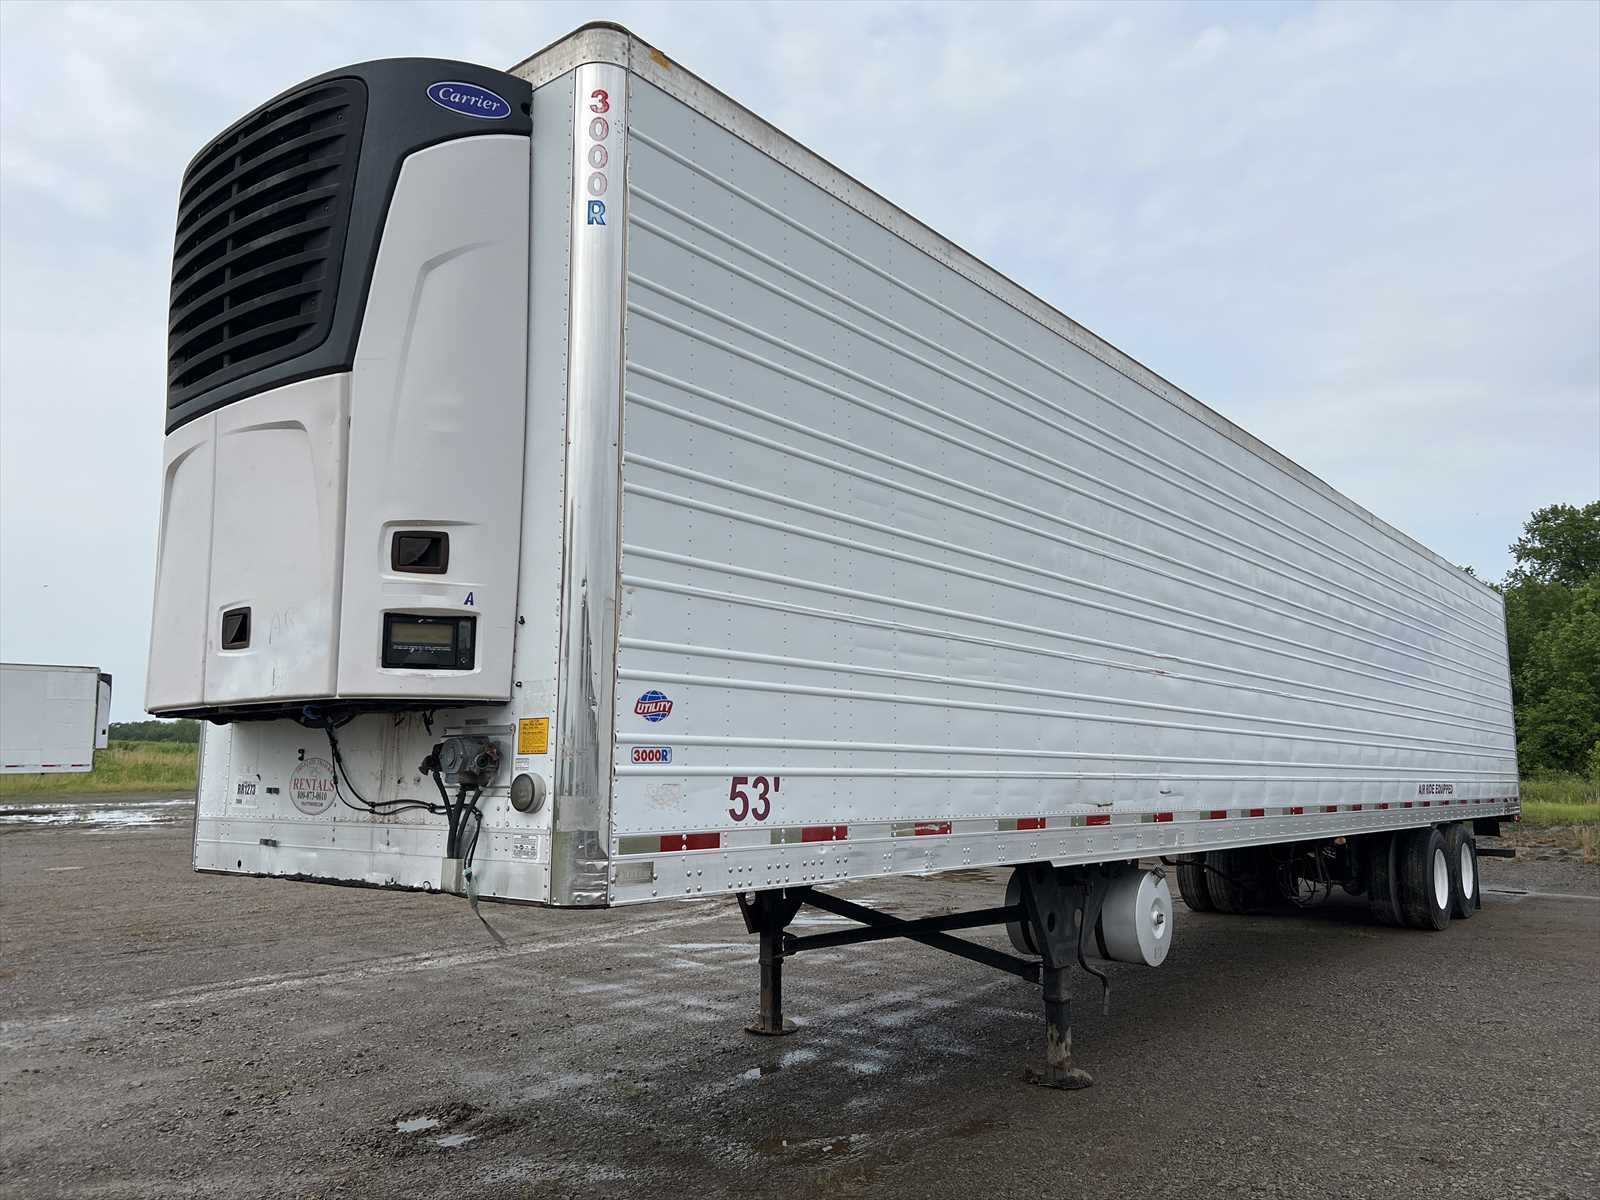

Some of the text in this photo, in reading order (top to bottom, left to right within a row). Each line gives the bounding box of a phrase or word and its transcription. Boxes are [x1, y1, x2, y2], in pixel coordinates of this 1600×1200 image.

[438, 87, 501, 112] Carrier
[587, 89, 610, 226] 3000R
[463, 591, 475, 606] A
[637, 701, 672, 714] UTILITY
[633, 749, 668, 762] 3000R
[293, 778, 335, 792] RENTALS
[1418, 784, 1454, 794] AIR RIDE EQUIPPED
[729, 776, 781, 822] 53'
